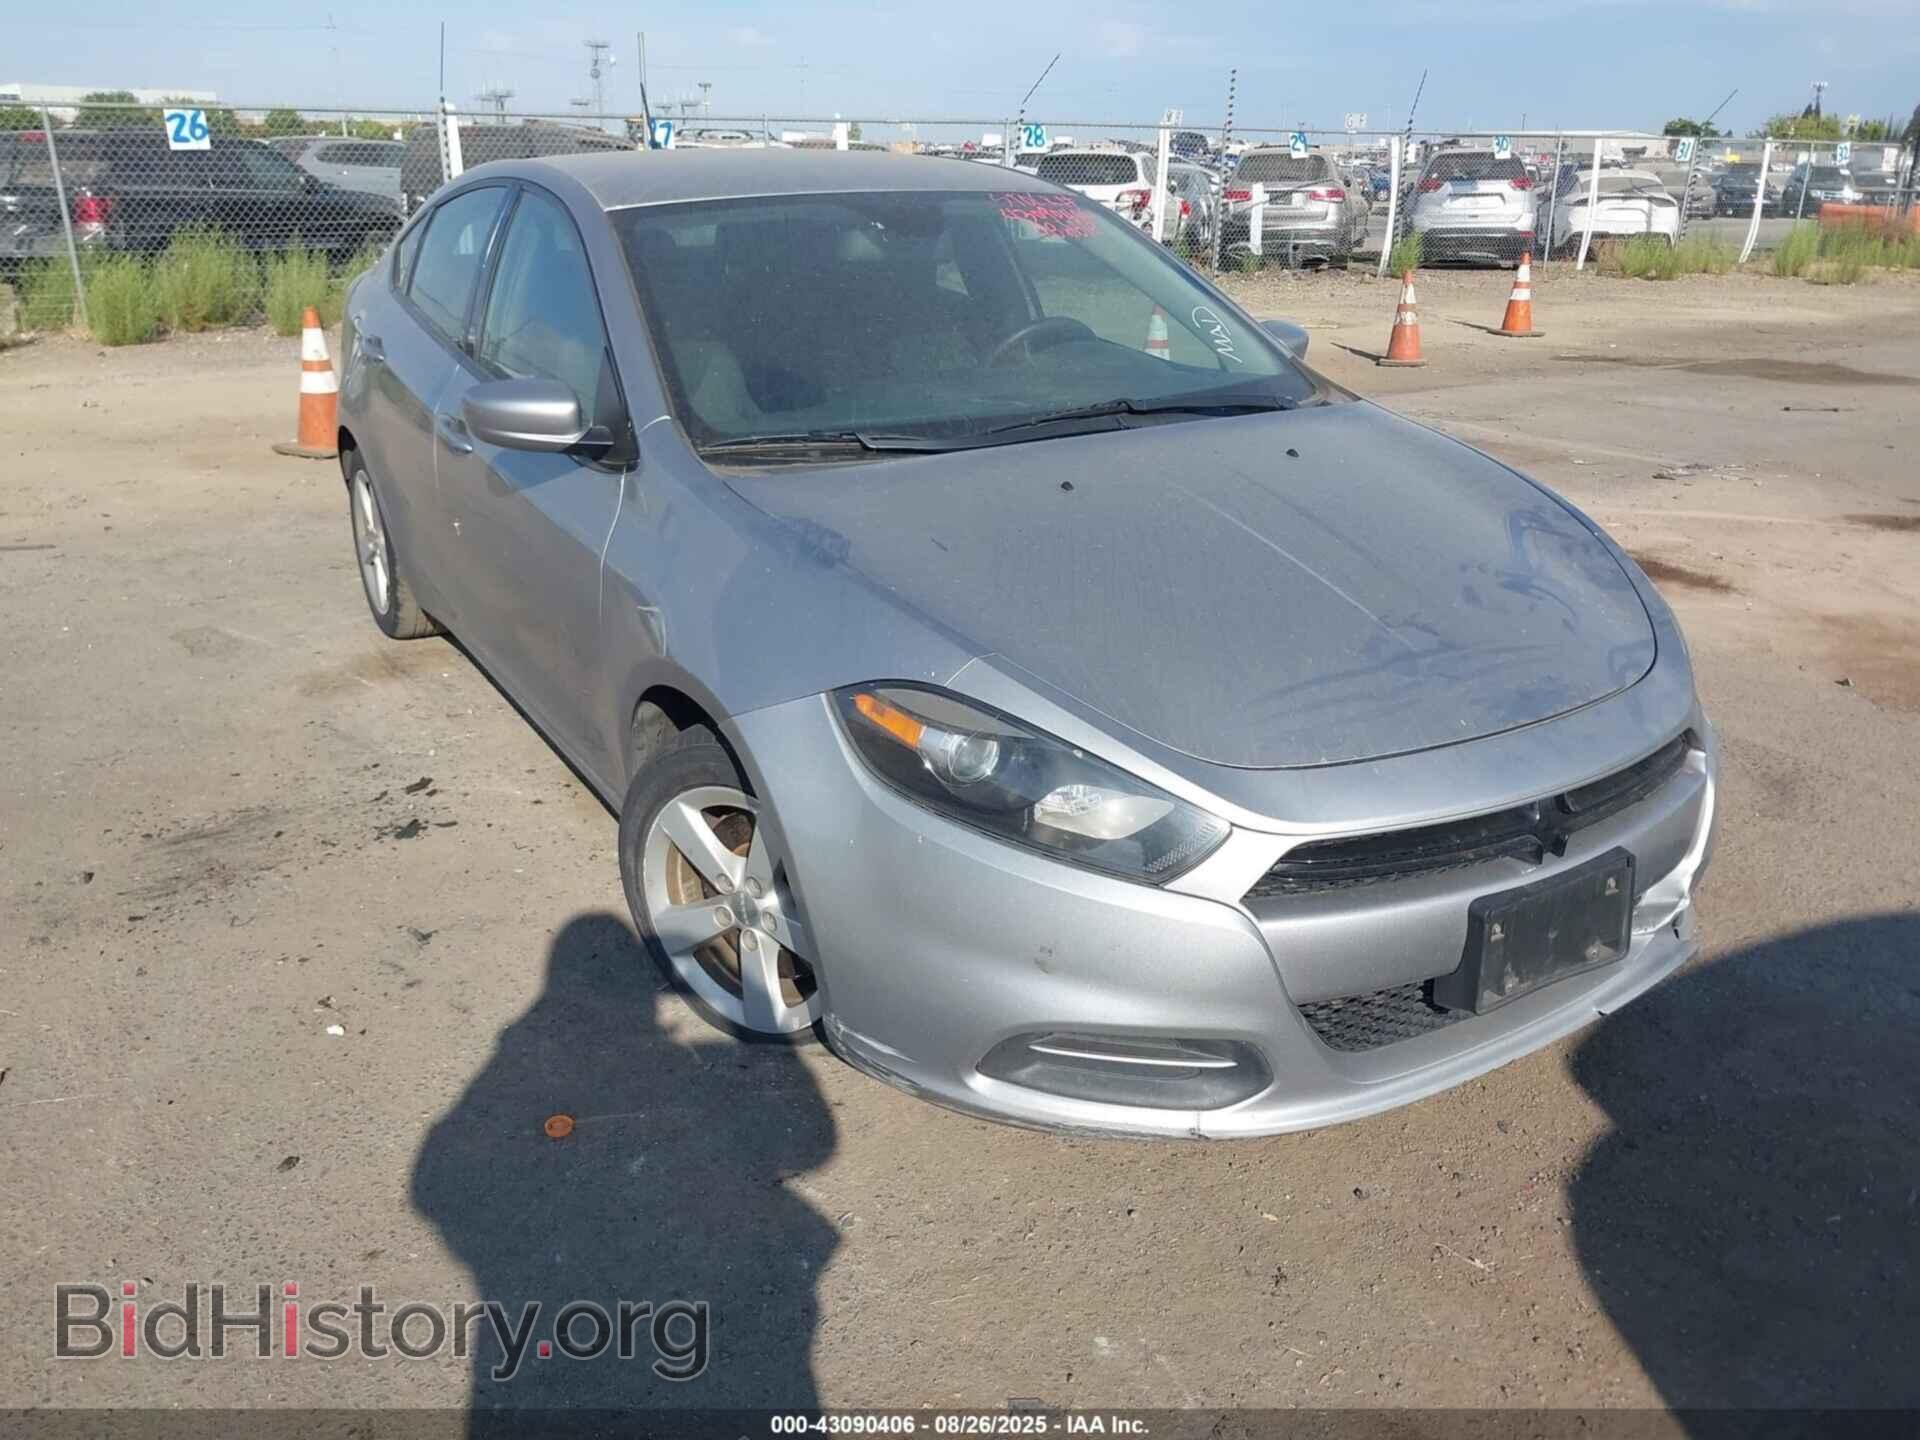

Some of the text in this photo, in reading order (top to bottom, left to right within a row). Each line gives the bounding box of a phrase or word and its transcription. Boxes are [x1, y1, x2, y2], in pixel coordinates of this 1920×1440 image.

[166, 109, 209, 143] 26
[1023, 123, 1046, 147] 28
[1290, 131, 1308, 153] 29
